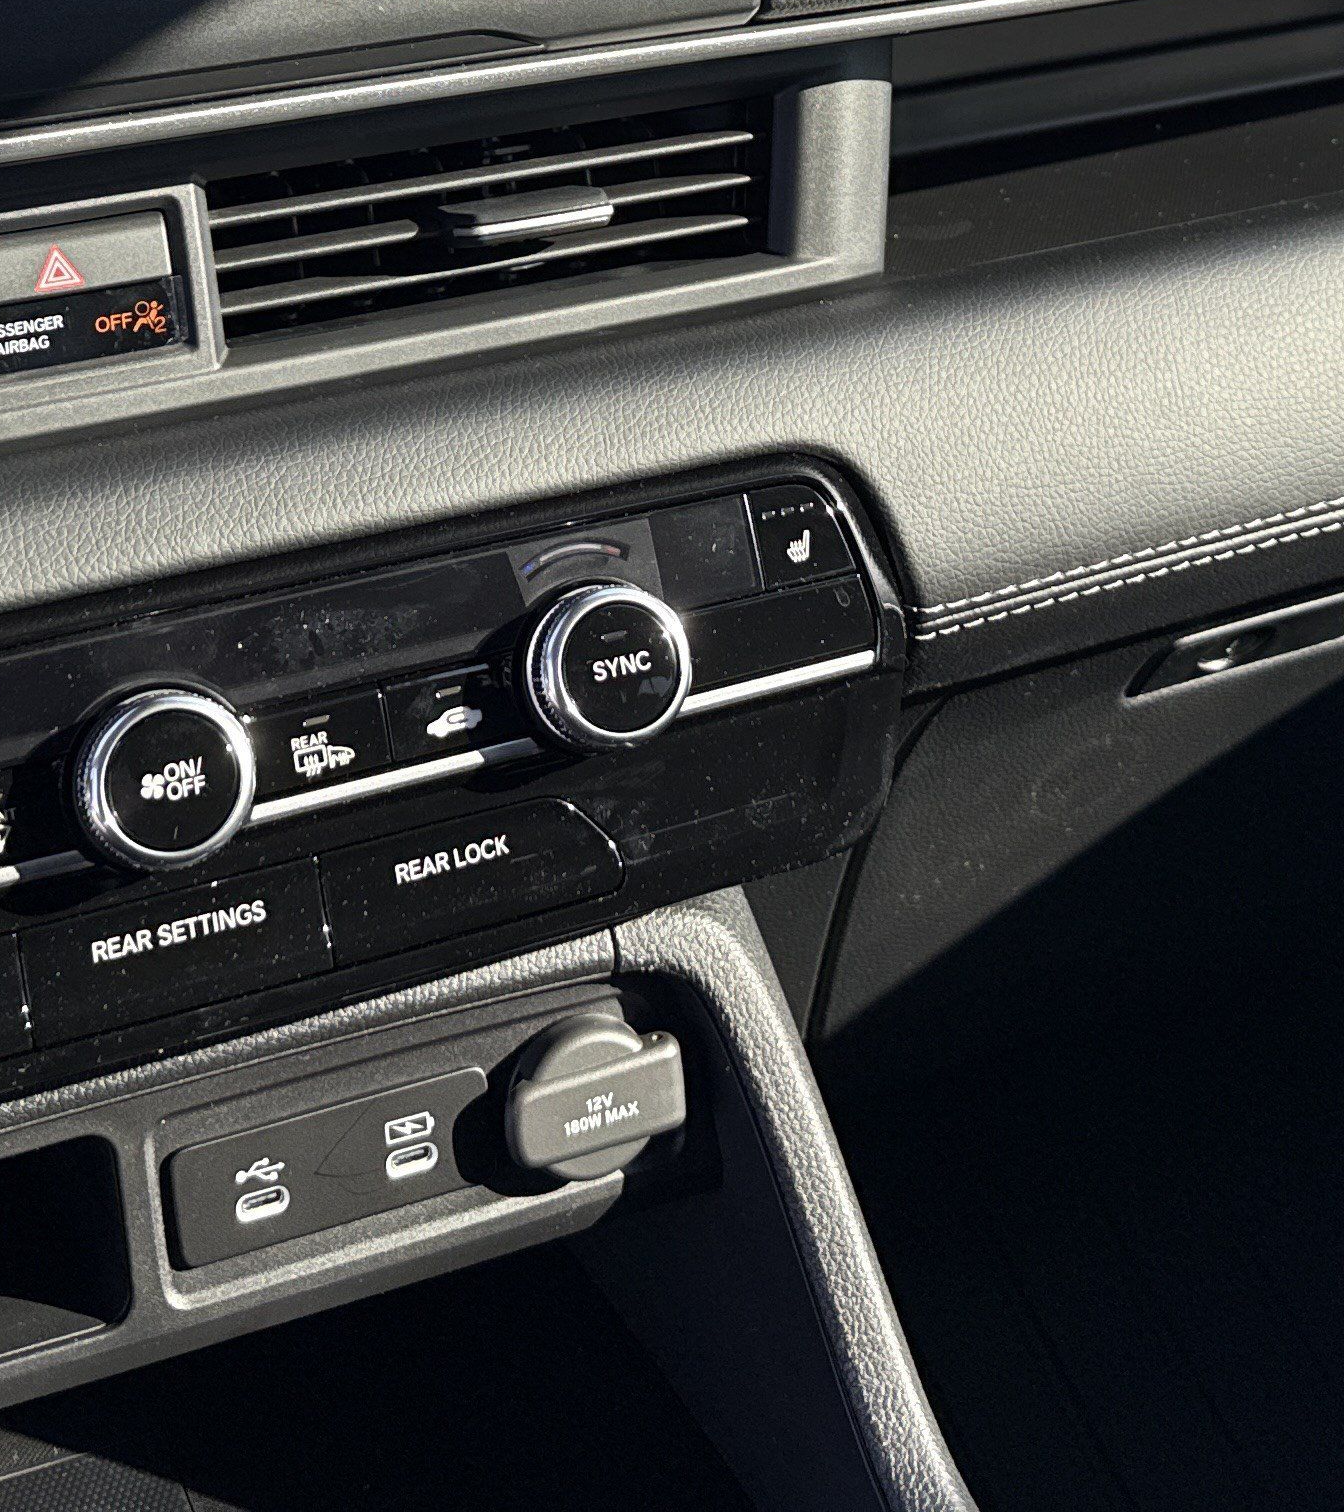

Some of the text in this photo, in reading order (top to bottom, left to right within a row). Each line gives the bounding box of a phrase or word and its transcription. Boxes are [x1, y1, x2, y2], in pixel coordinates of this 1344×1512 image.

[95, 312, 132, 332] OFF
[593, 651, 651, 681] SYNC
[290, 730, 329, 752] REAR
[162, 755, 204, 784] ON/
[165, 774, 208, 802] OFF
[395, 835, 509, 884] REAR LOCK
[92, 900, 266, 963] REAR SETTINGS
[586, 1091, 614, 1113] 12V
[564, 1100, 640, 1137] 180W MAX
